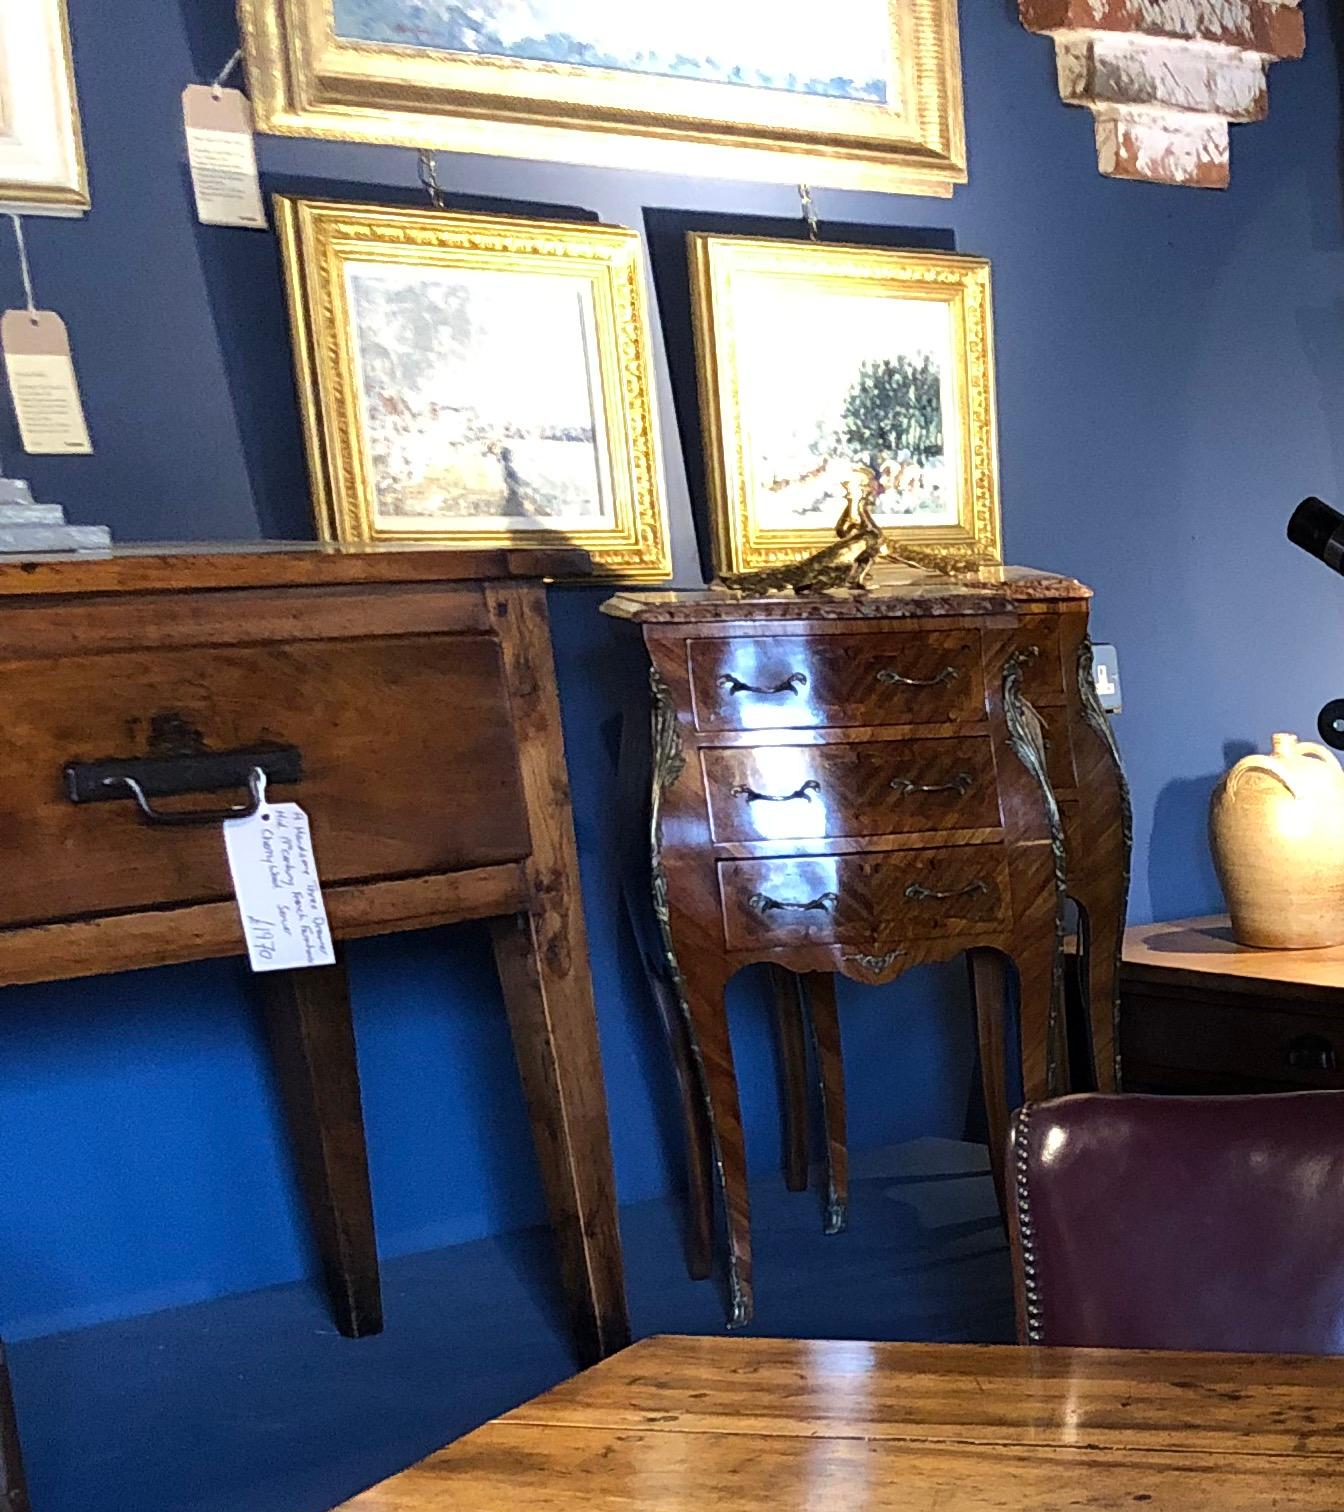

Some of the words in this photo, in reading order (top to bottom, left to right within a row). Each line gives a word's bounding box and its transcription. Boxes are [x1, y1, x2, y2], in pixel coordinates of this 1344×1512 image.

[275, 810, 289, 828] Mid
[292, 891, 308, 921] French
[311, 916, 329, 956] Drawer
